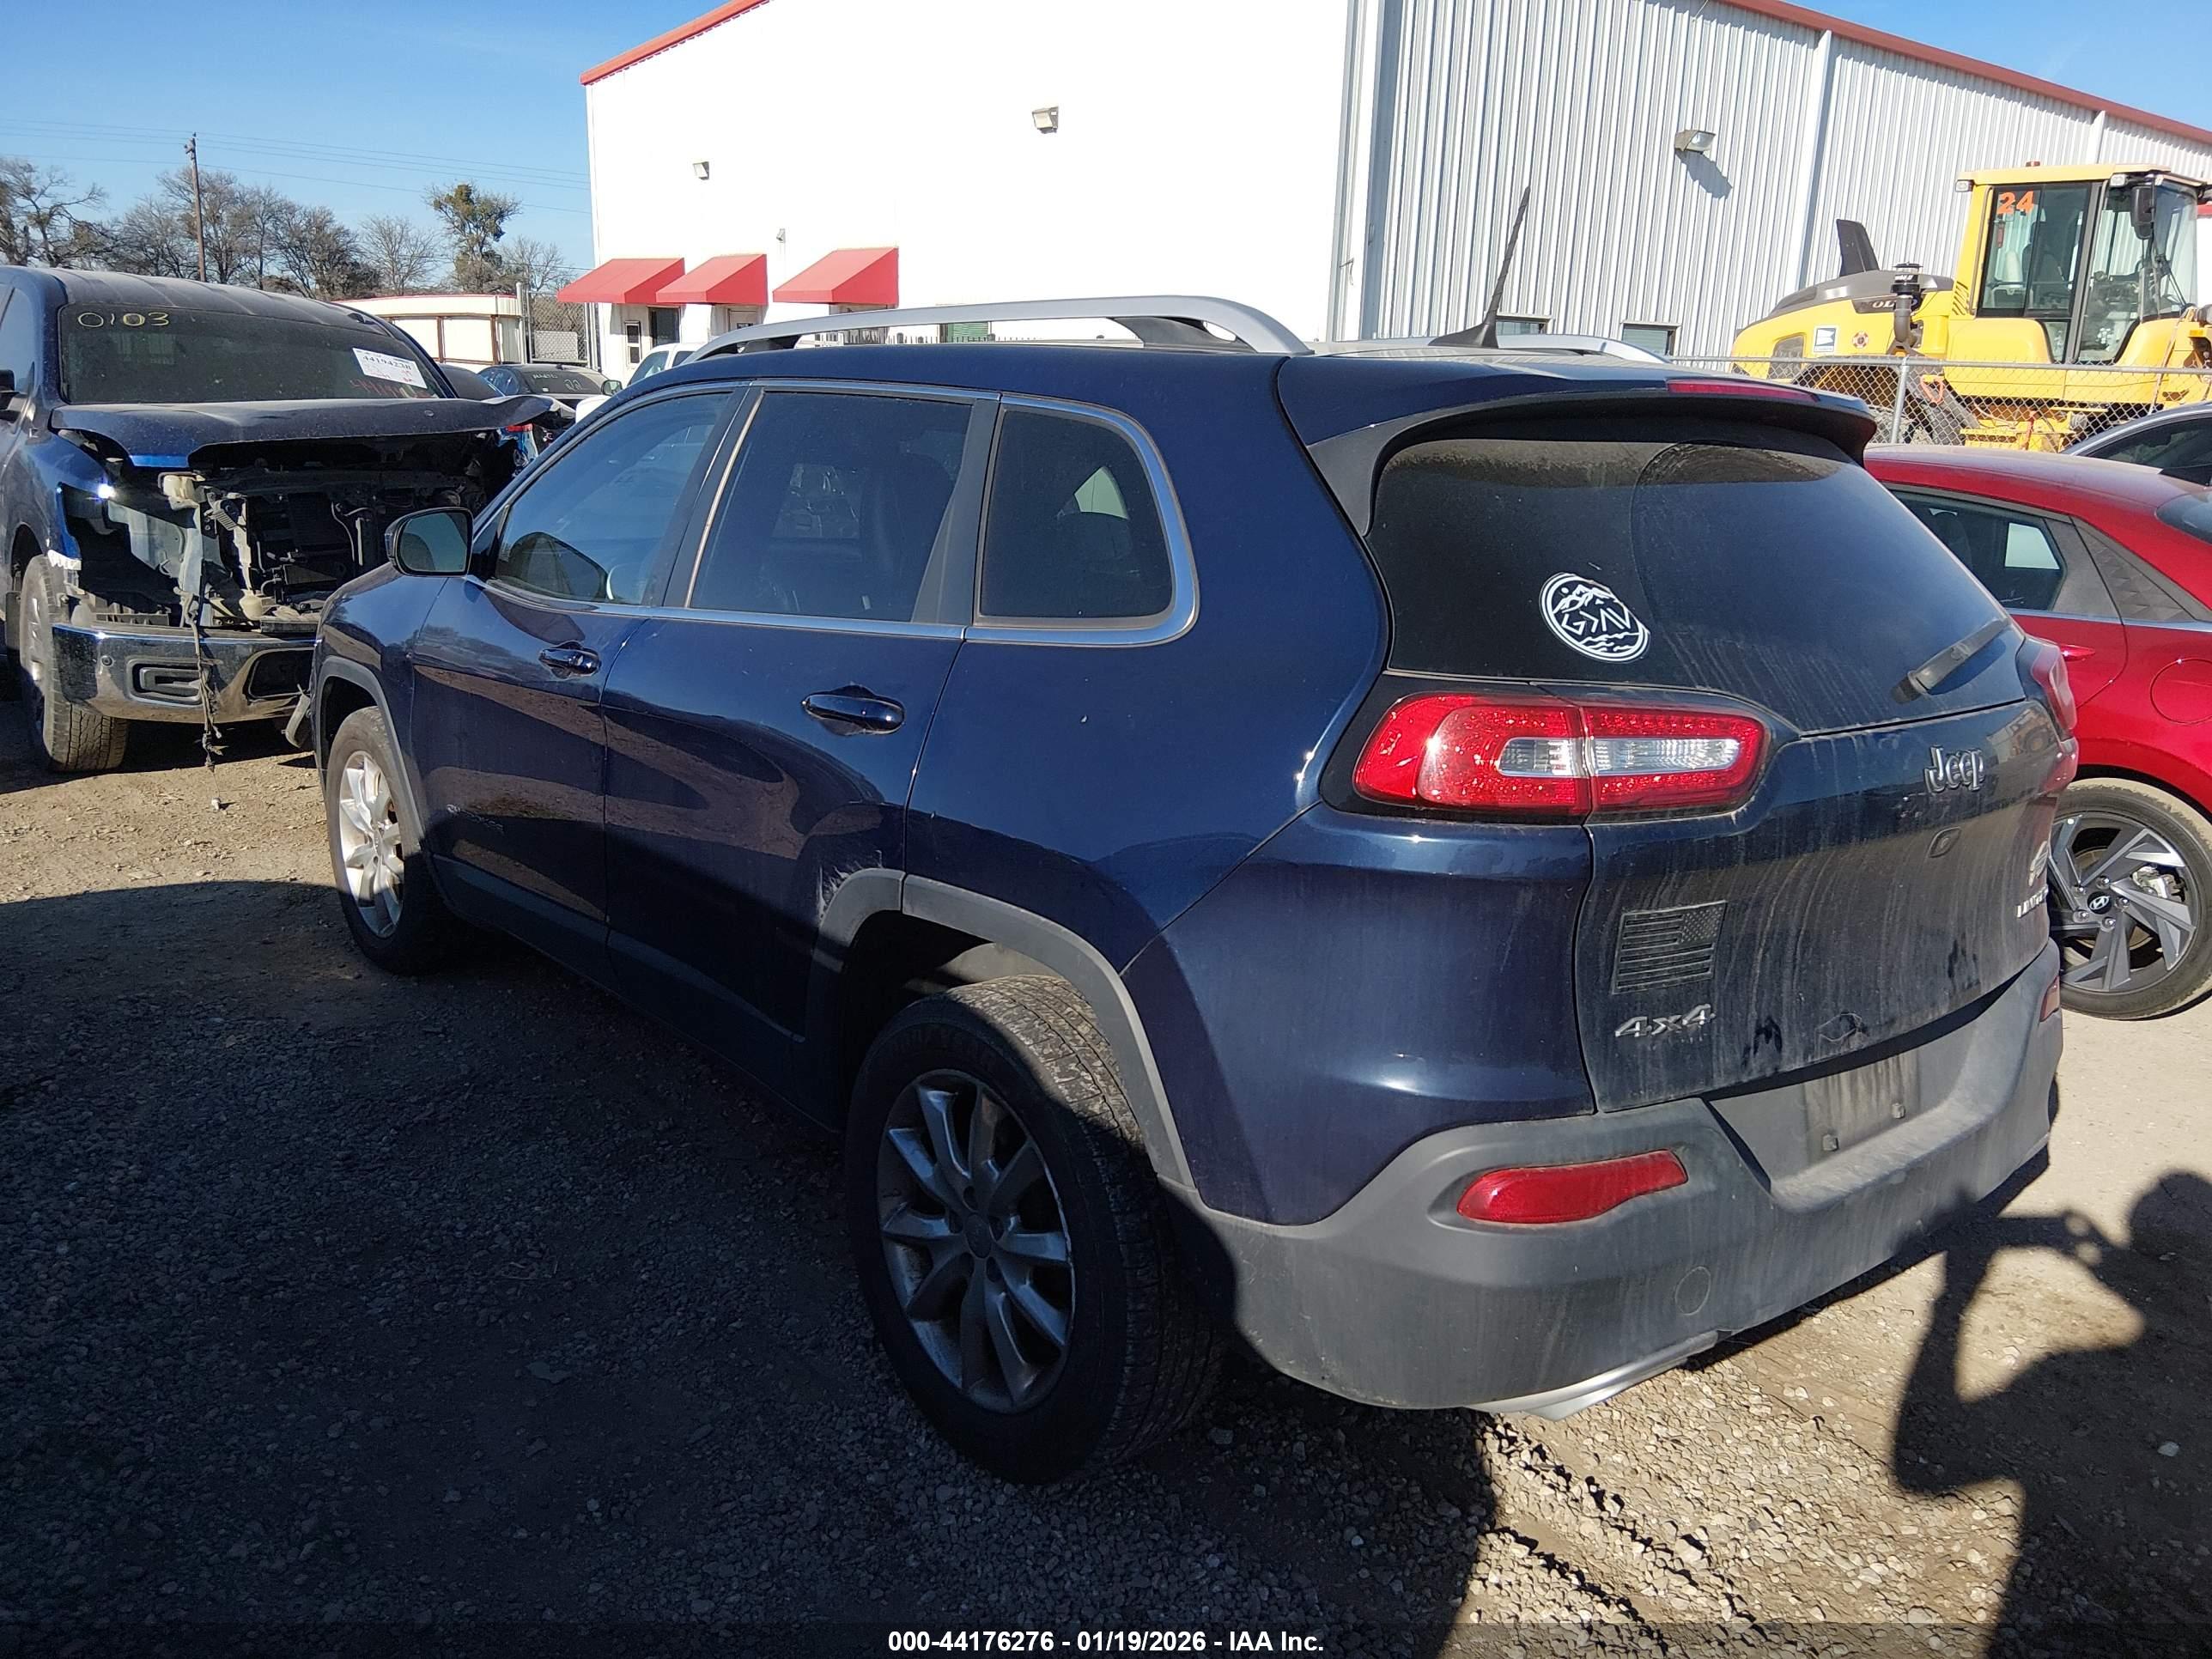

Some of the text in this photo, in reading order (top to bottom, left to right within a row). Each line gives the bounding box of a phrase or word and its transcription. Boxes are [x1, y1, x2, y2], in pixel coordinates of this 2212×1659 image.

[1996, 191, 2034, 214] 24
[1923, 744, 1985, 794] Jeep
[1614, 1003, 1716, 1037] 4x4
